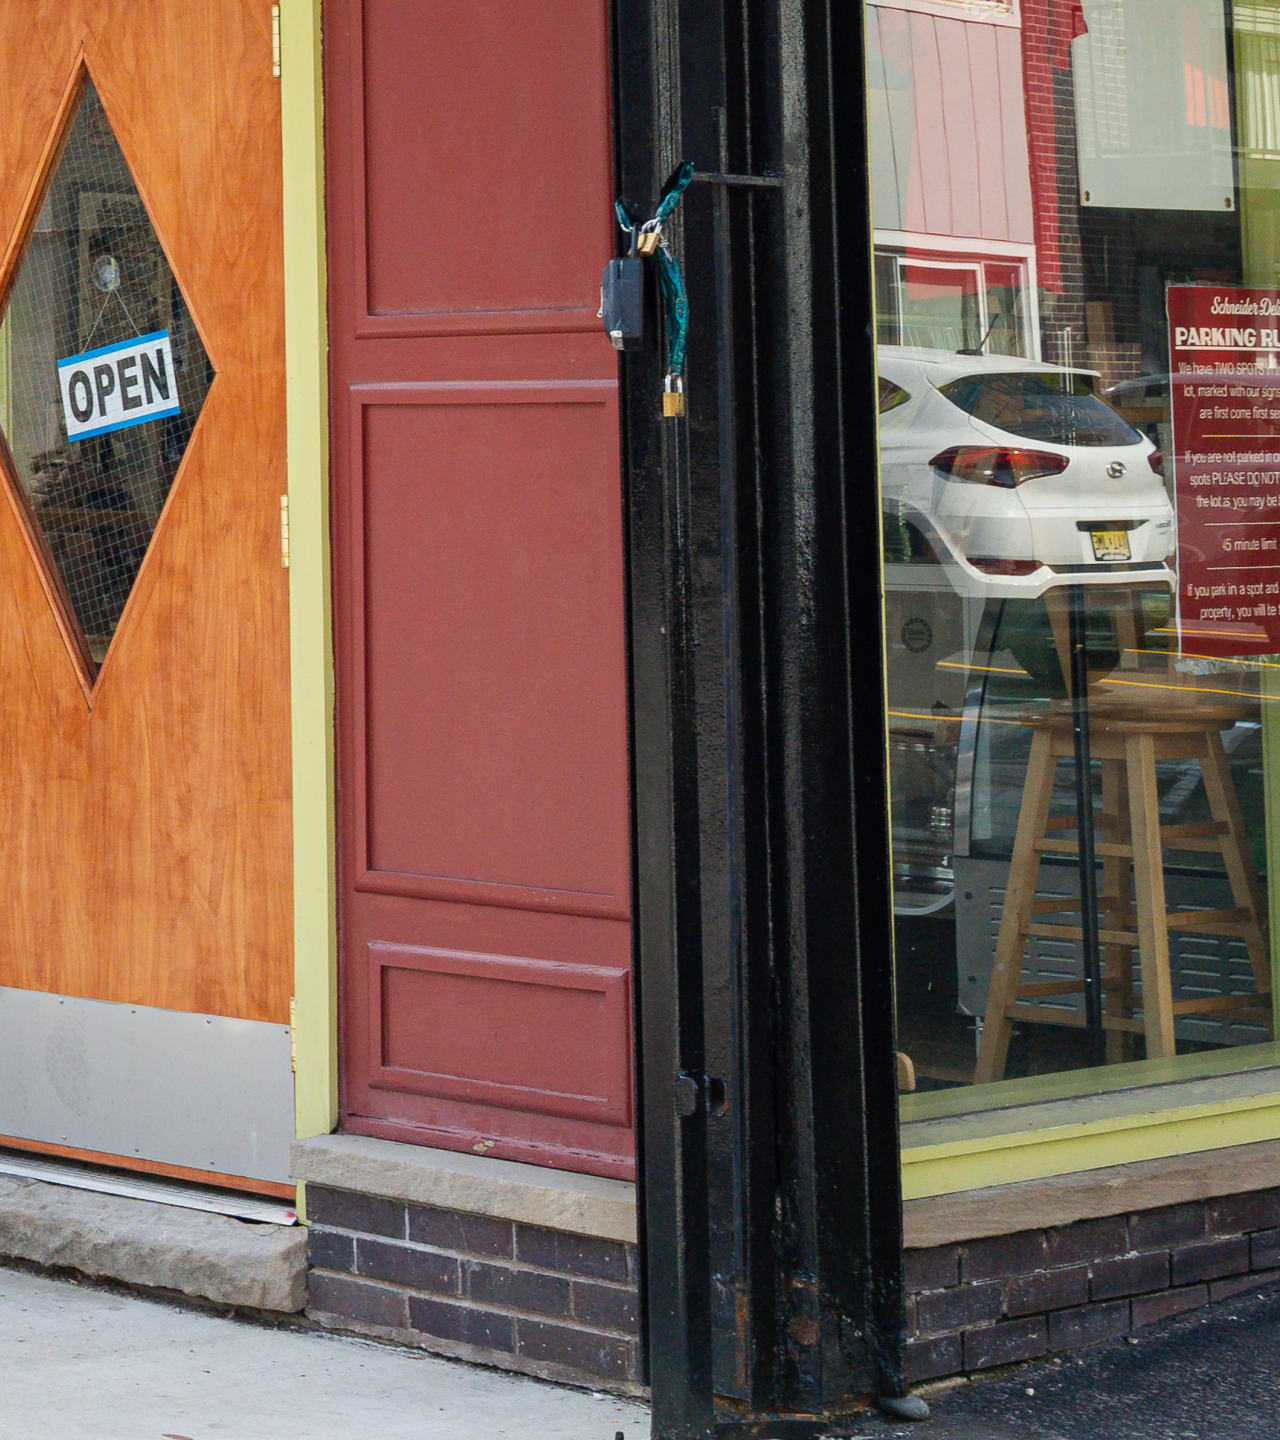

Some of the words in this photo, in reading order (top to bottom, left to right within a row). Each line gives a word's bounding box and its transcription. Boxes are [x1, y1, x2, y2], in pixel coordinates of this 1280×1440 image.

[1210, 295, 1258, 316] Schneider
[1175, 327, 1257, 347] PARKING
[1214, 362, 1235, 375] TWO
[1236, 362, 1265, 376] SPOTS
[68, 347, 170, 423] OPEN
[1192, 453, 1206, 466] you
[1207, 452, 1222, 463] are
[1211, 472, 1246, 485] PLEASE
[1194, 586, 1210, 600] you
[1211, 583, 1227, 599] park
[1227, 582, 1238, 596] in
[1239, 584, 1246, 595] a
[1247, 582, 1264, 598] spot
[1236, 607, 1252, 621] you
